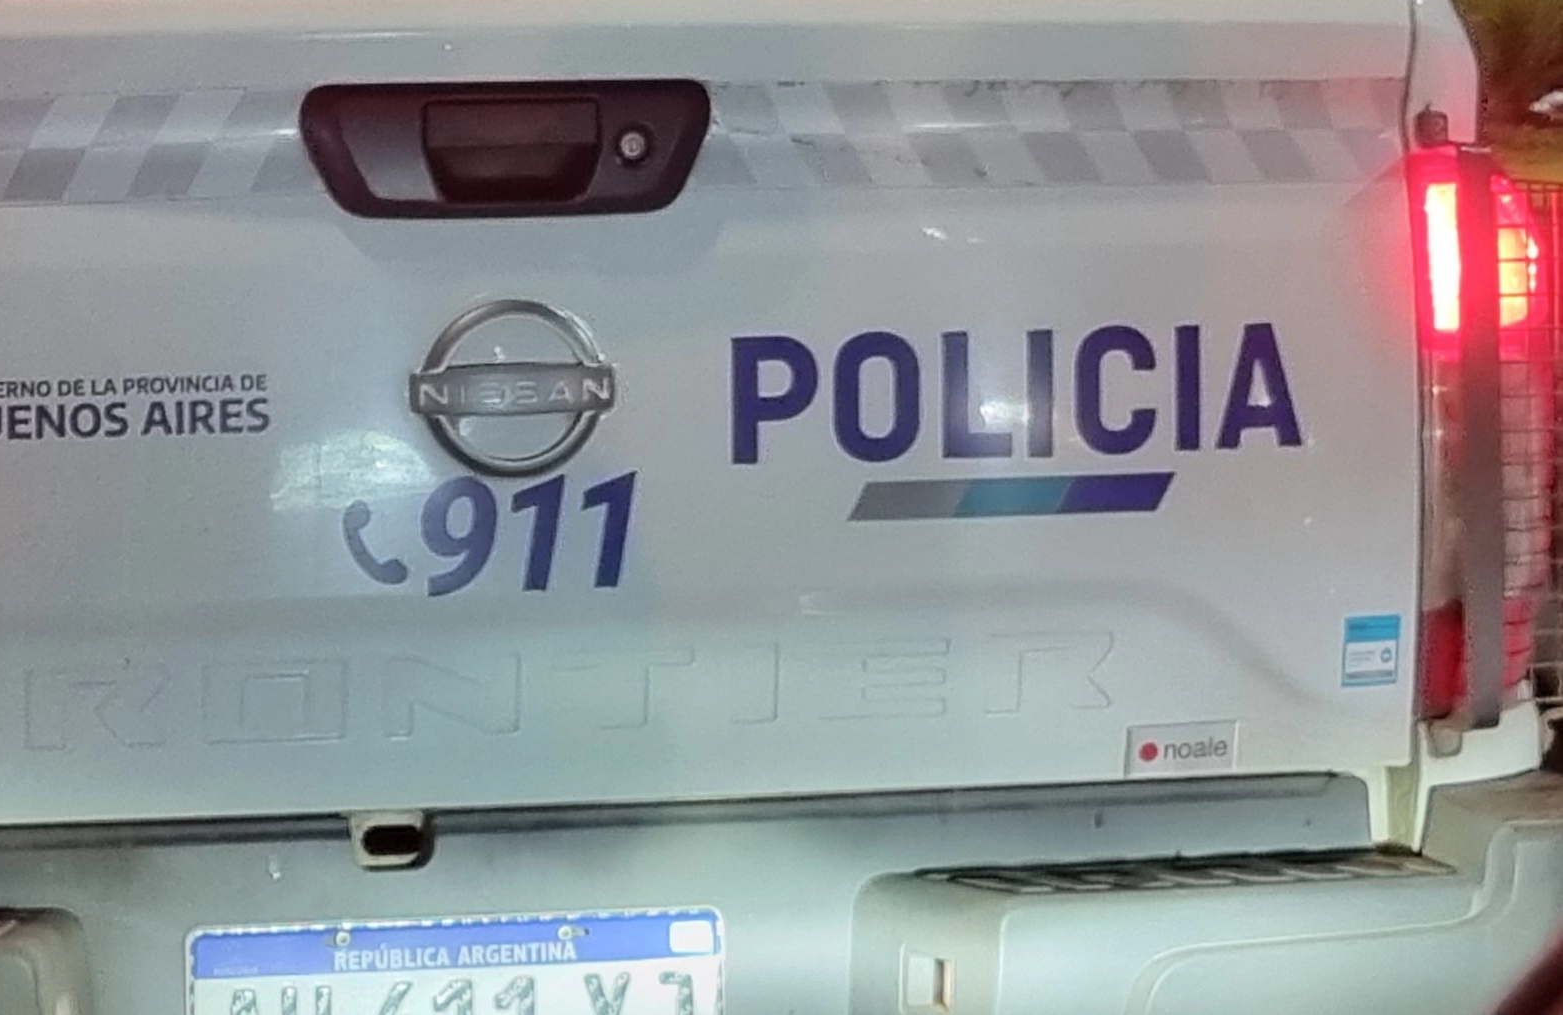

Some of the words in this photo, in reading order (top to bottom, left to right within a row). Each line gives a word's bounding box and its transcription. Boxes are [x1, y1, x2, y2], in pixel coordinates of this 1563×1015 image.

[57, 379, 86, 397] DE
[90, 378, 117, 396] LA
[122, 375, 234, 395] PROVINCIA
[240, 374, 268, 391] DE
[418, 376, 611, 407] NISSAN
[730, 322, 1303, 465] POLICIA
[140, 397, 271, 437] AIRES
[421, 470, 637, 597] 911
[1163, 736, 1228, 759] noale
[332, 942, 450, 971] REPÚBLICA
[457, 940, 577, 966] ARGENTINA
